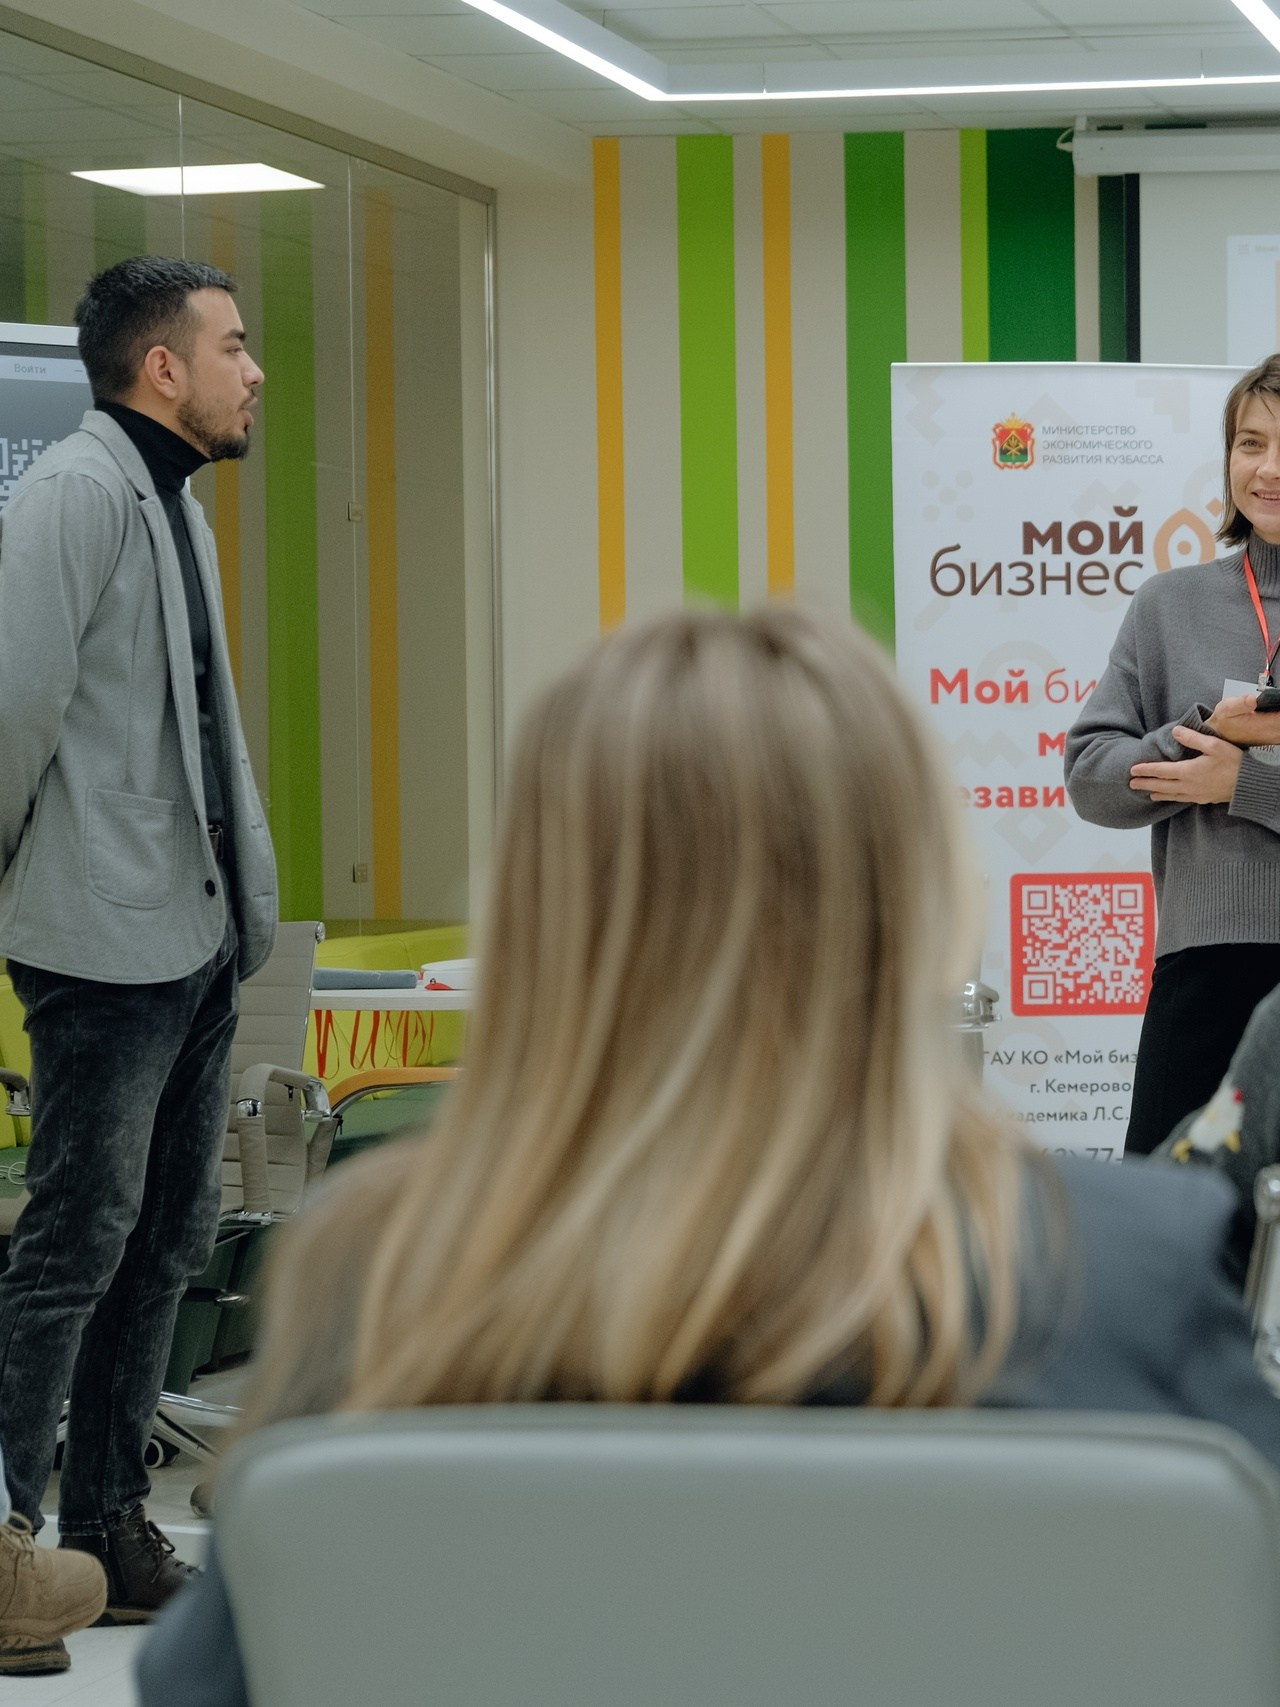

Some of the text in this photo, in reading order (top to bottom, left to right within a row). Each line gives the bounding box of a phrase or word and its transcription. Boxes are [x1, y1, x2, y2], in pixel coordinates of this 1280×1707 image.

[13, 362, 47, 374] Войти
[1042, 424, 1136, 435] МИНИСТЕРСТВО
[1042, 440, 1153, 450] ЭКОНОМИЧЕСКОГО
[1042, 455, 1164, 465] РАЗВИТИЯ КУЗБАССА
[1022, 505, 1144, 555] мой
[929, 544, 1144, 597] бизнес
[930, 668, 1029, 704] Мой
[957, 786, 1071, 808] зави
[1021, 1050, 1049, 1065] КО
[1054, 1049, 1103, 1064] «Мой
[1030, 1078, 1132, 1096] г. Кемерово
[1093, 1105, 1129, 1121] Л.С.
